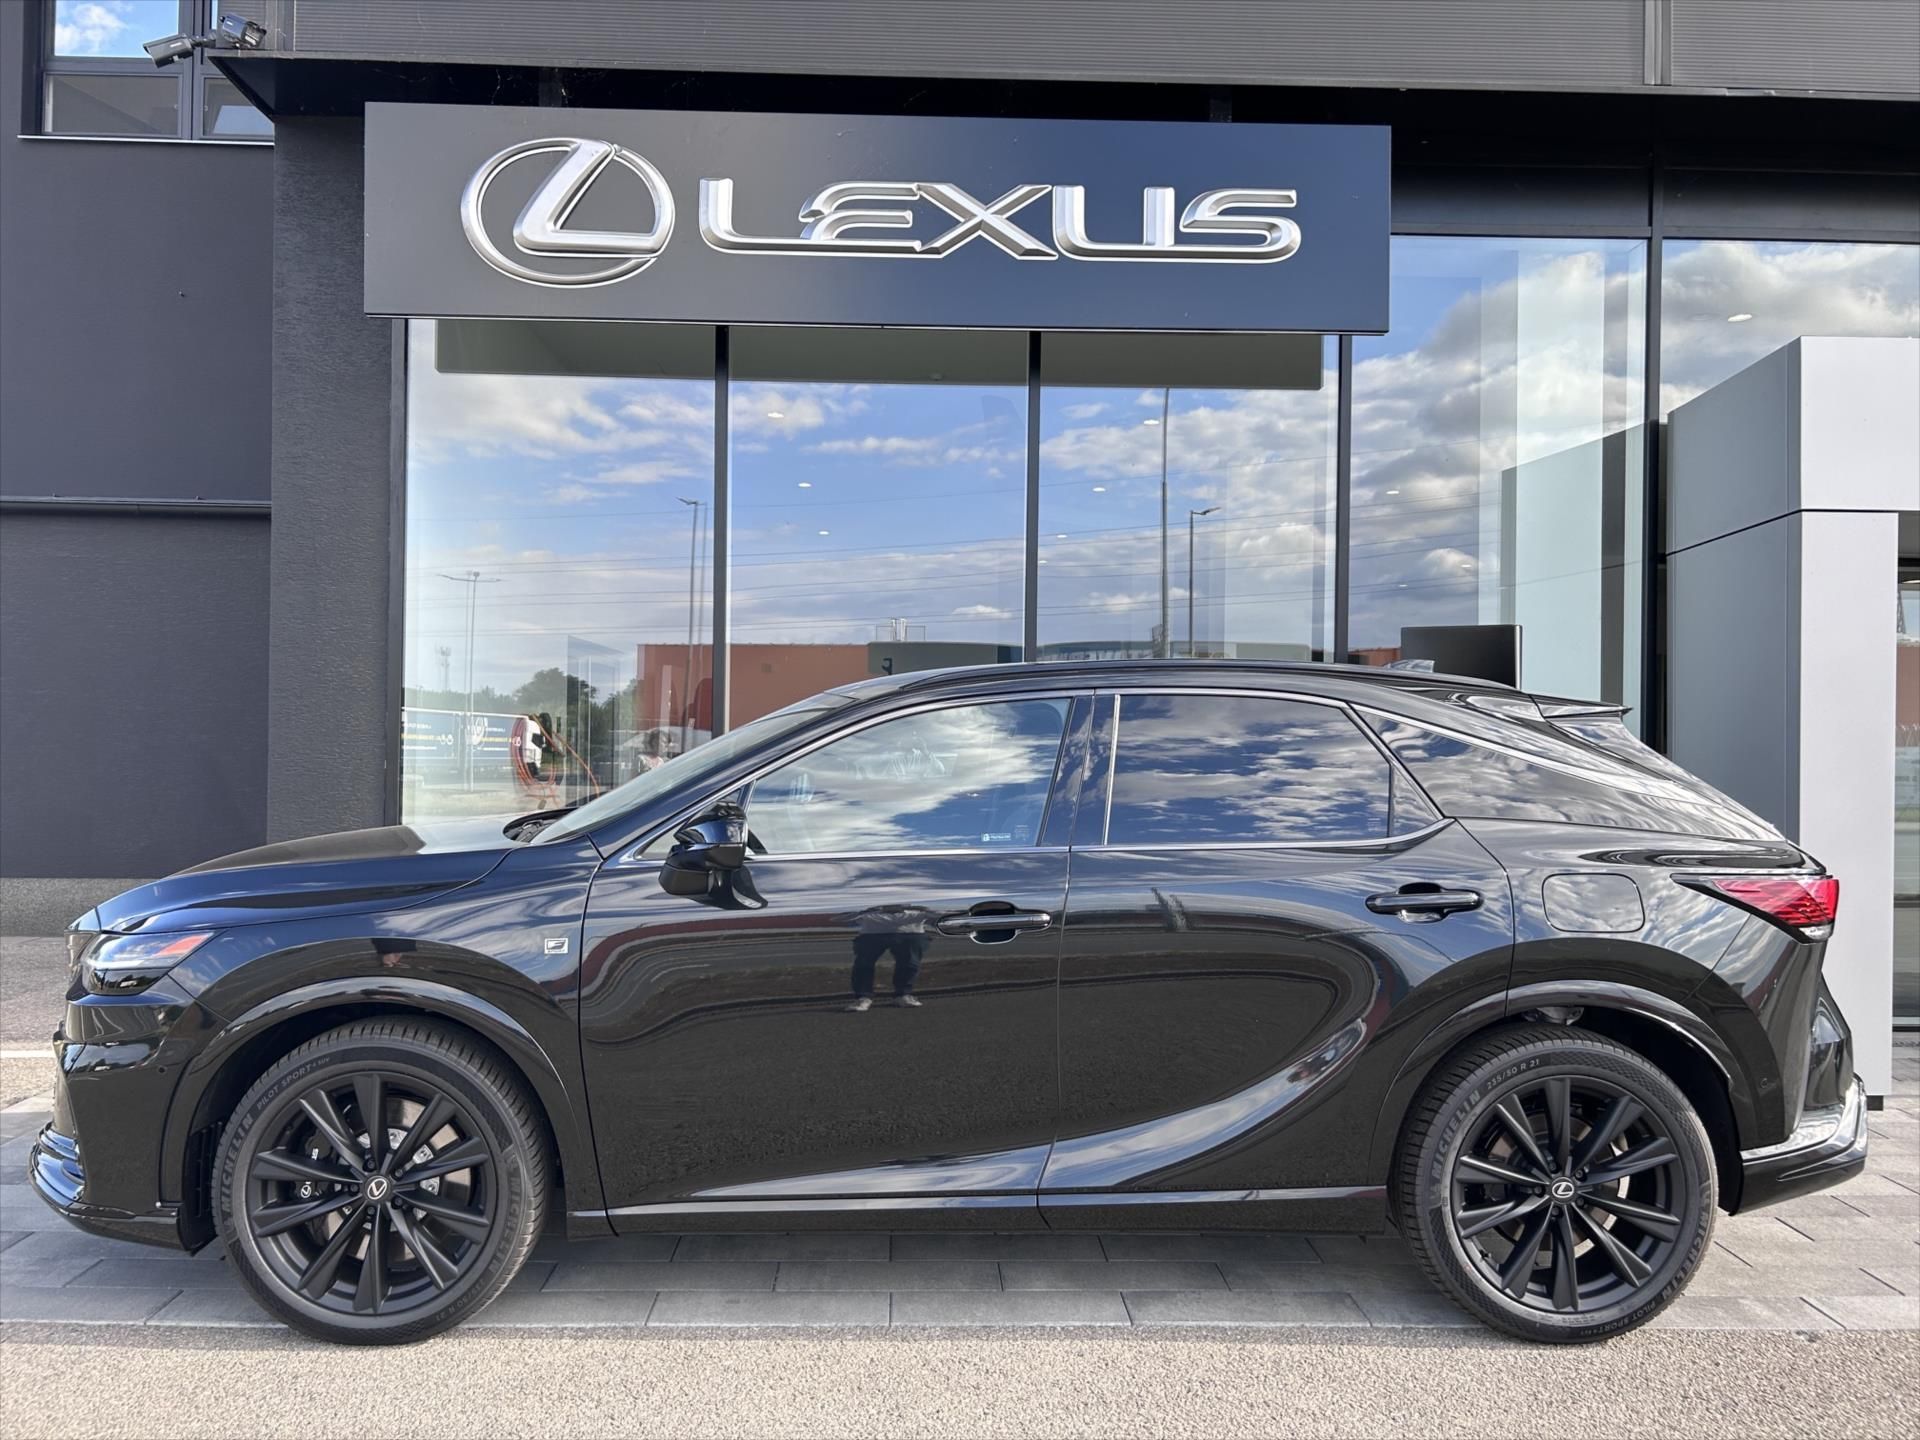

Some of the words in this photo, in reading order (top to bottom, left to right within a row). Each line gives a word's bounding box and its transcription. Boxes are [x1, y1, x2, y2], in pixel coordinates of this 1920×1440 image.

[699, 178, 1301, 263] LEXUS
[256, 1085, 279, 1111] PILOT
[281, 1063, 312, 1087] SPORT
[1487, 1066, 1518, 1090] 235/50
[1520, 1062, 1527, 1072] R
[1529, 1058, 1540, 1068] 21
[221, 1112, 254, 1214] MICHELIN
[1431, 1090, 1480, 1179] MICHELIN
[487, 1176, 521, 1275] MICHELIN
[1661, 1210, 1708, 1300] MICHELIN
[1599, 1316, 1629, 1334] SPORT
[1631, 1300, 1657, 1321] PILOT
